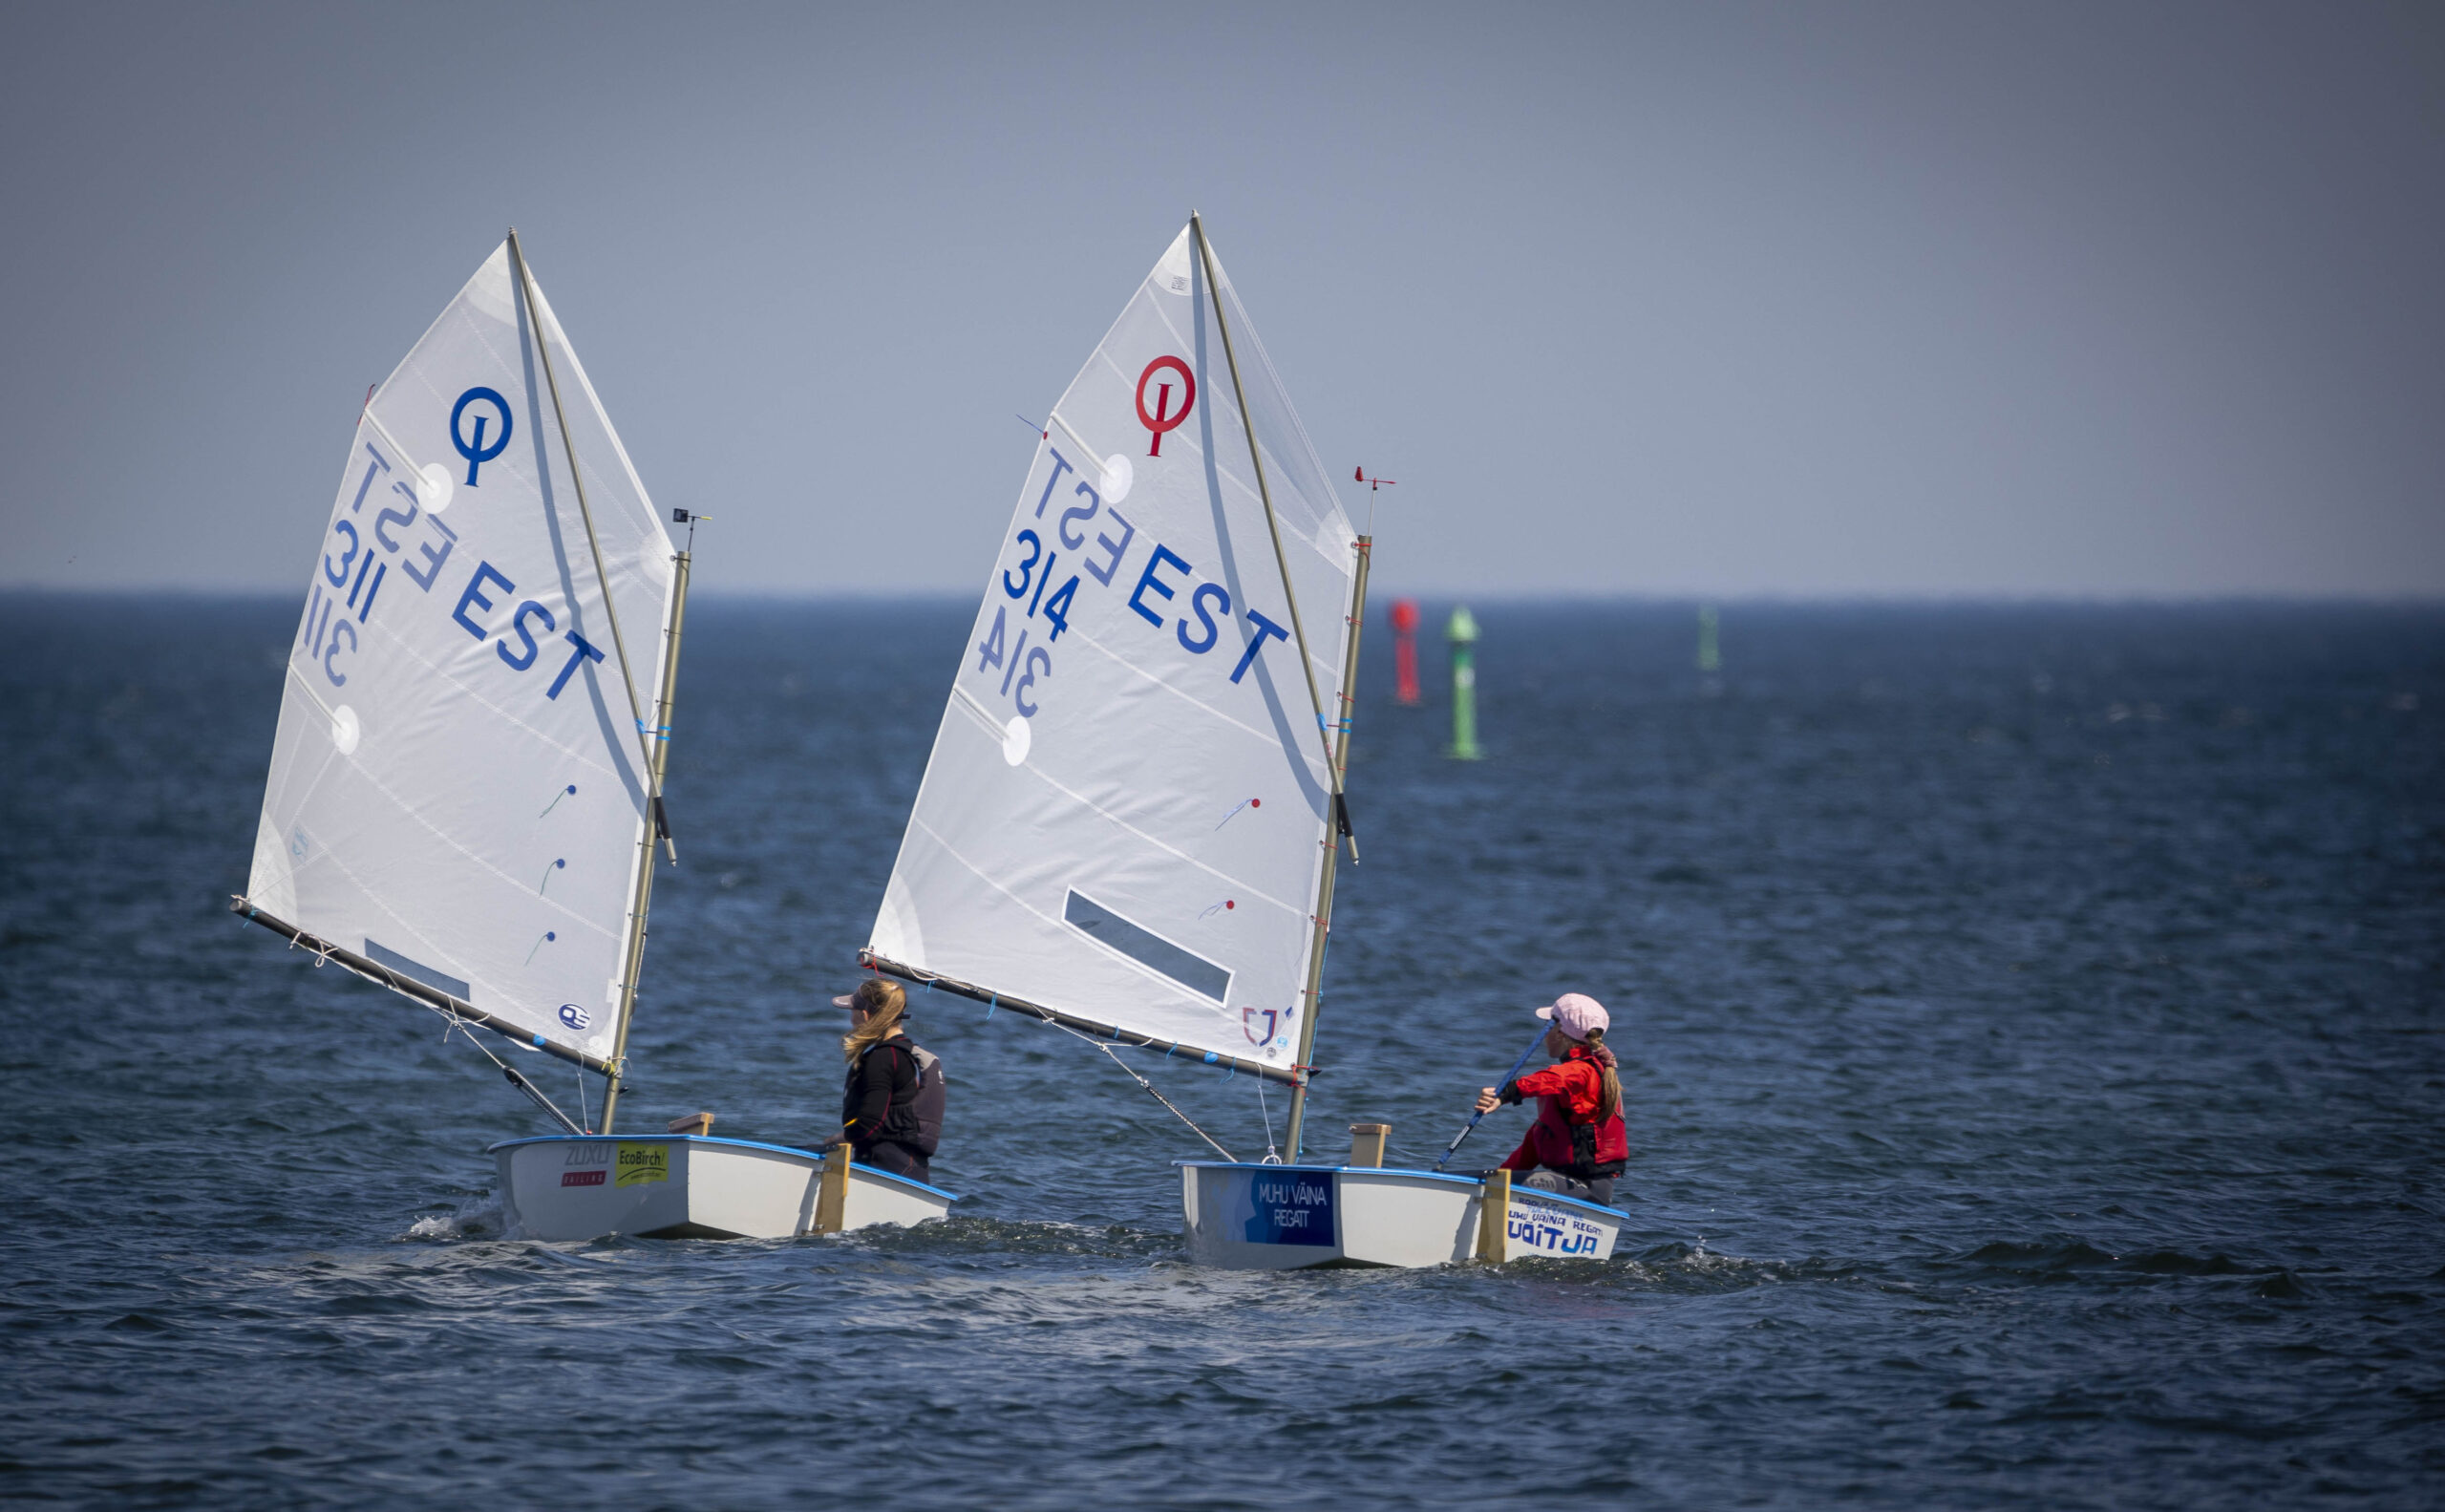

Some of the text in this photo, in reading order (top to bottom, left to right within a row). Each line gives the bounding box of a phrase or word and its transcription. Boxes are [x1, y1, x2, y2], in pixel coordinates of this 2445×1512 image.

[325, 520, 387, 624] 311
[1003, 529, 1080, 643] 314
[1127, 543, 1289, 685] EST
[452, 560, 606, 701] EST
[1259, 1181, 1327, 1205] MUHU VÄINA
[1274, 1209, 1309, 1227] REGATT
